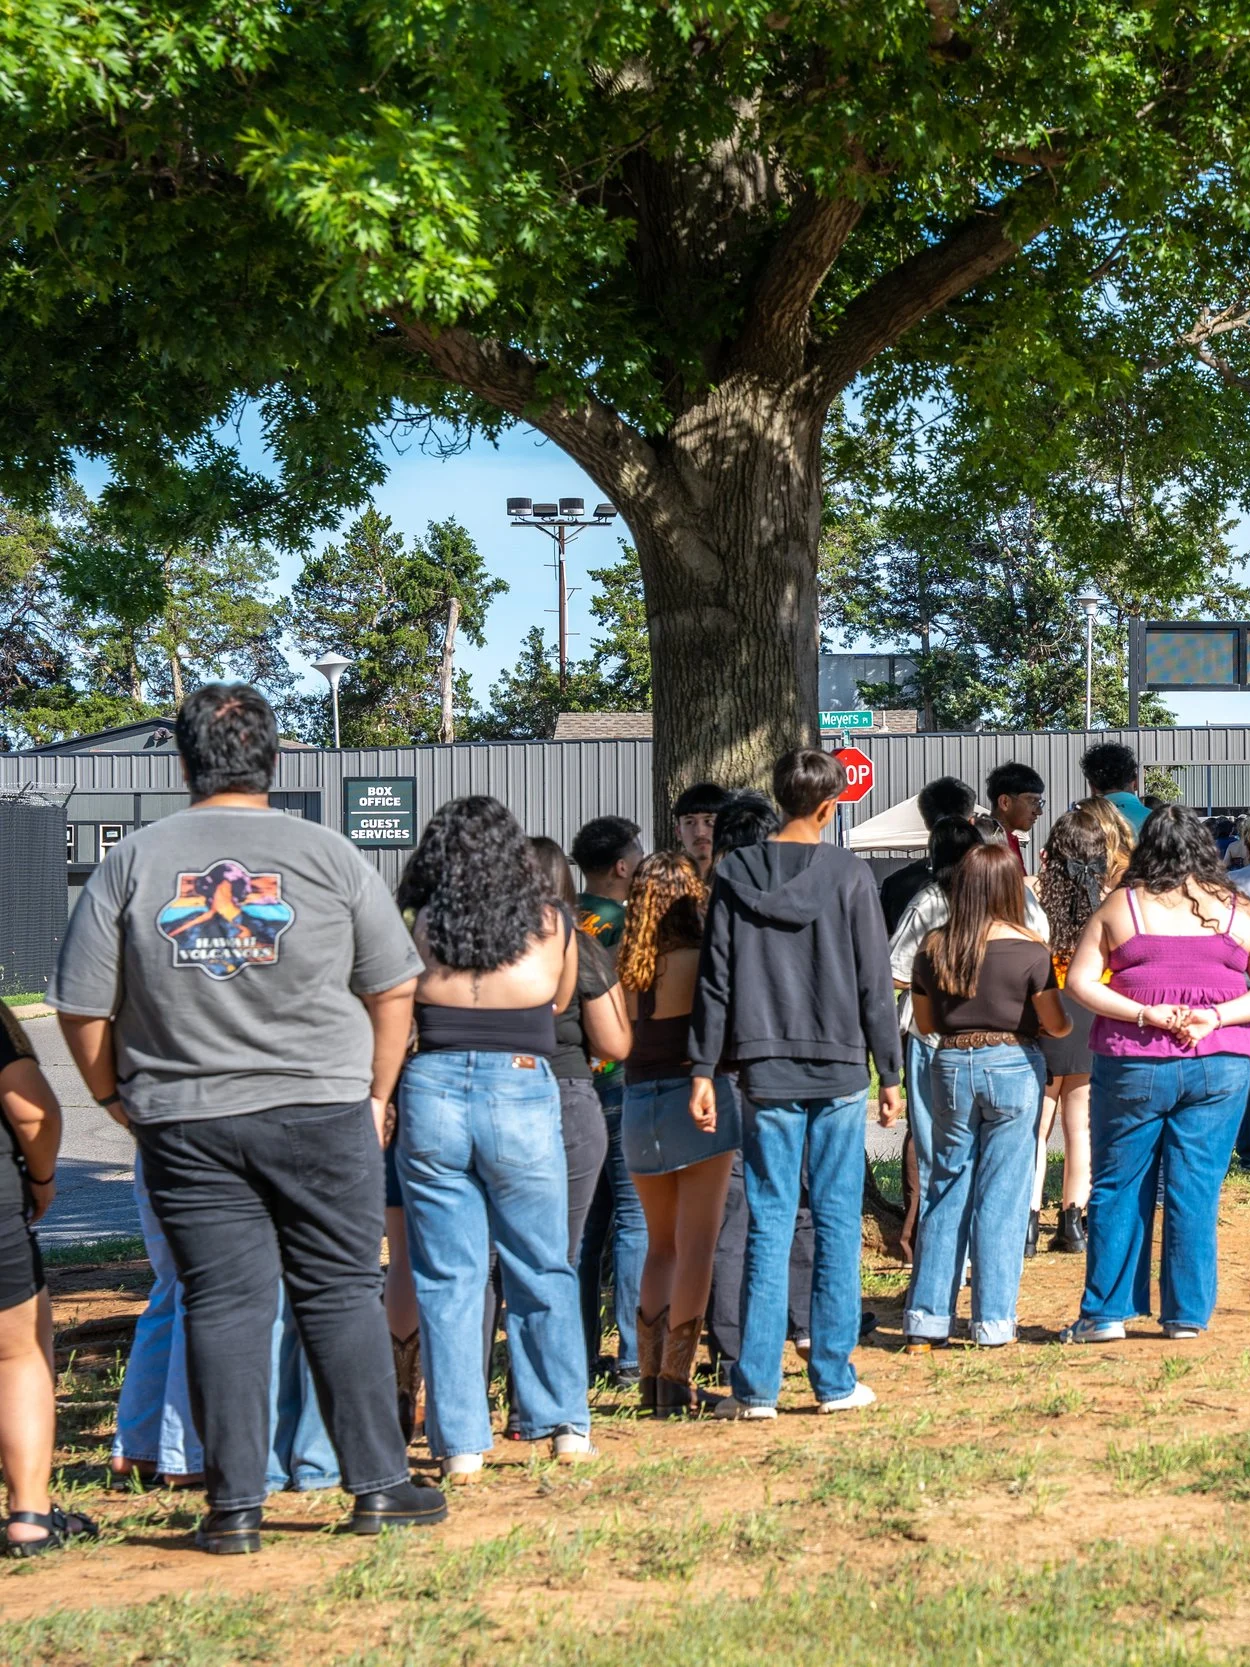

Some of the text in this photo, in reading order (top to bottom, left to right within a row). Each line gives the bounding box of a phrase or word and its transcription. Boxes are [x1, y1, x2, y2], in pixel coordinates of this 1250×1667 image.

[821, 712, 859, 728] Meyers
[846, 764, 870, 785] OP
[367, 786, 392, 796] BOX
[359, 797, 401, 806] OFFICE
[360, 819, 400, 828] GUEST
[350, 829, 410, 839] SERVICES
